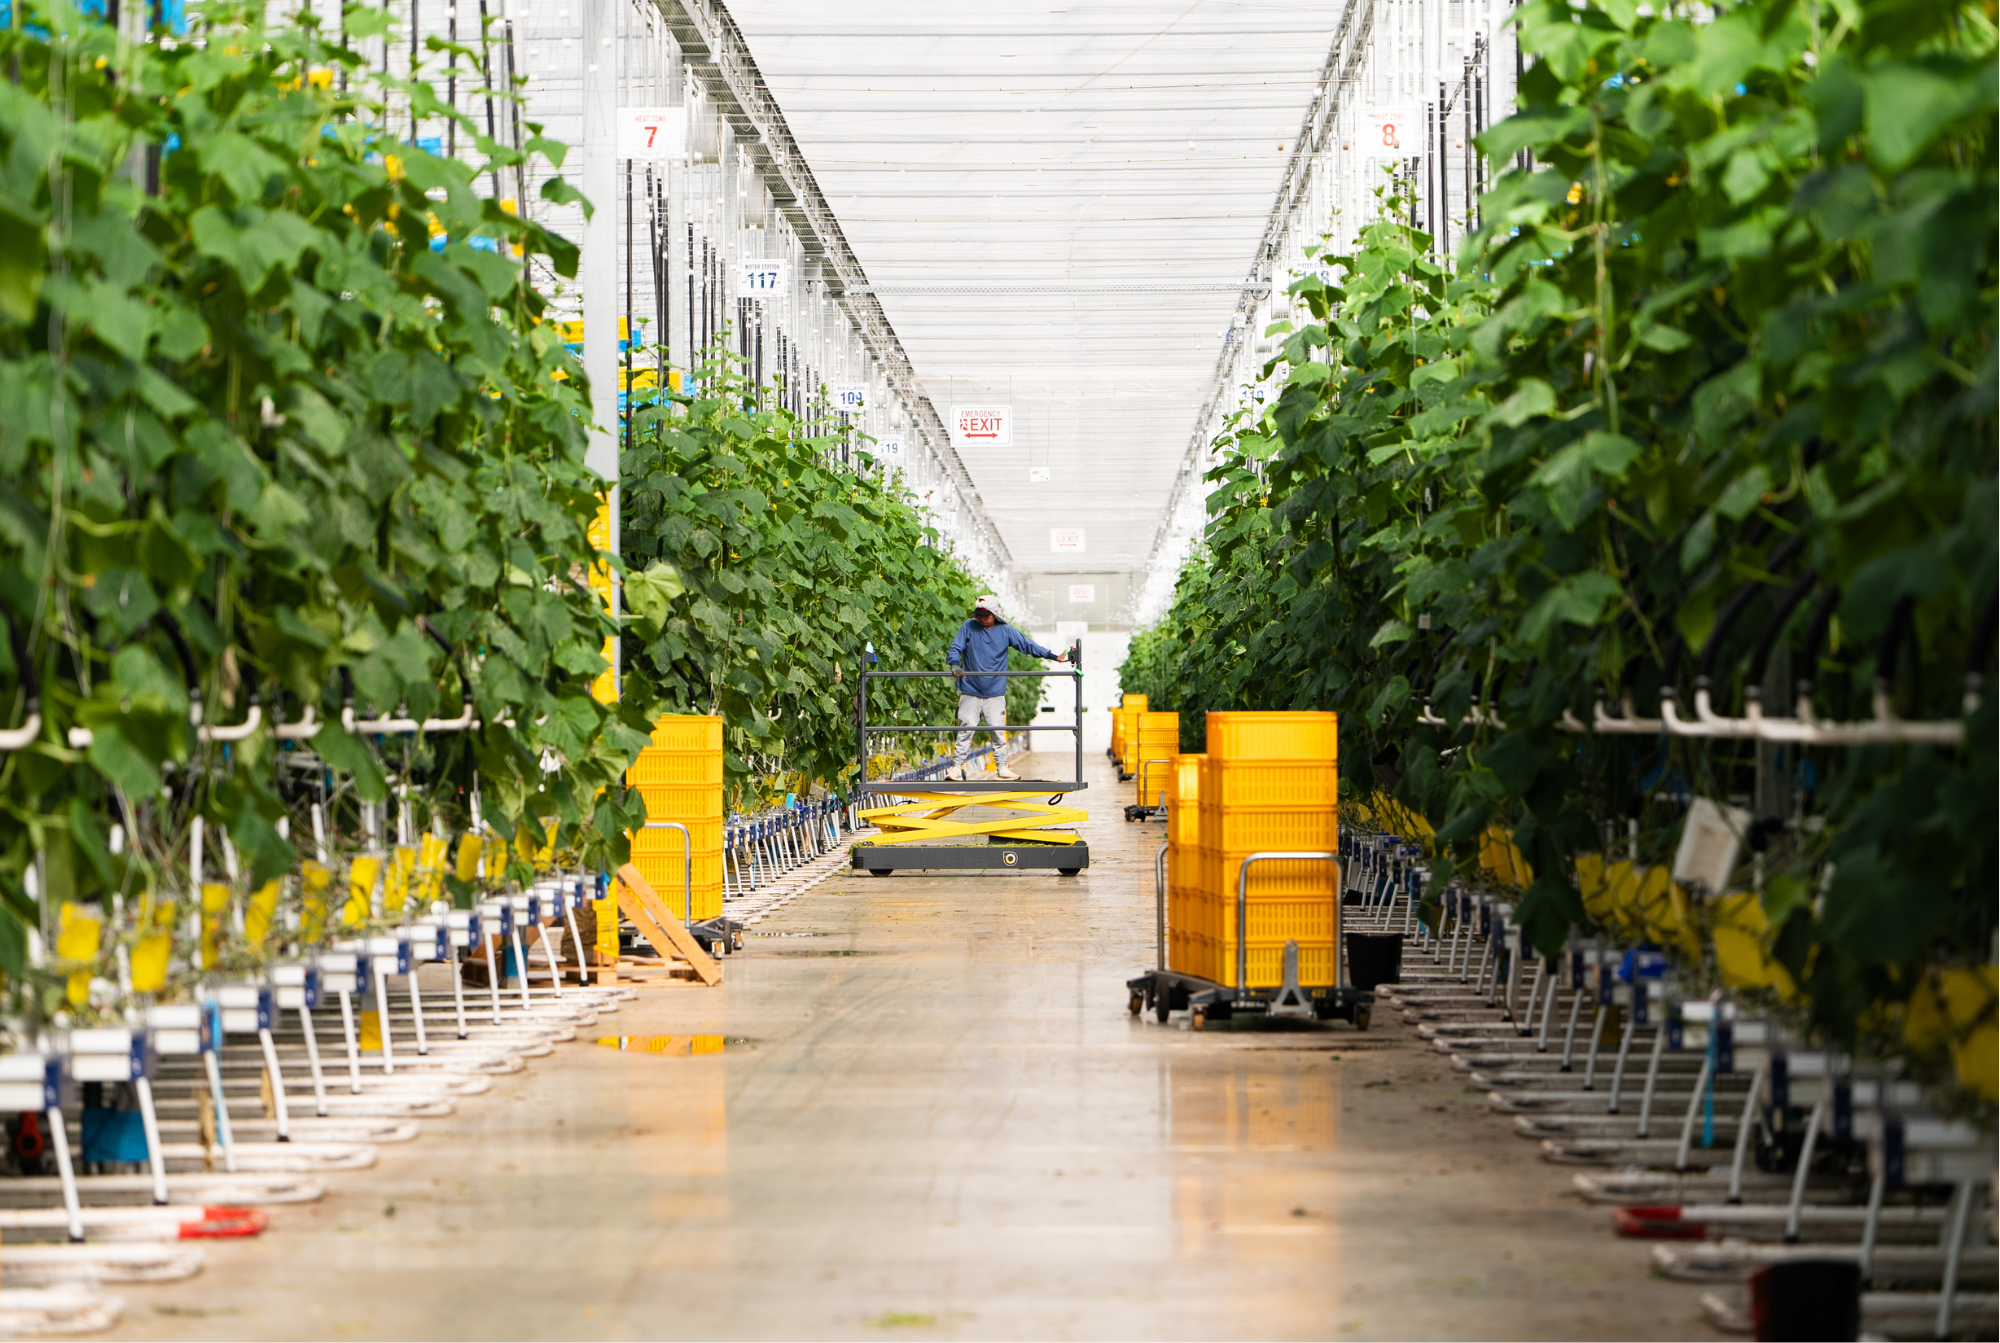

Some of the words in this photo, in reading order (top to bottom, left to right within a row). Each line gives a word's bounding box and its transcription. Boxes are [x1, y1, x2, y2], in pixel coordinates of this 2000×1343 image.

[644, 126, 657, 148] 7
[1382, 123, 1396, 146] 8
[748, 272, 777, 289] 117
[840, 391, 863, 405] 109
[961, 410, 1001, 418] EMERGENCY
[970, 418, 1003, 432] EXIT
[1061, 535, 1080, 543] EXIT
